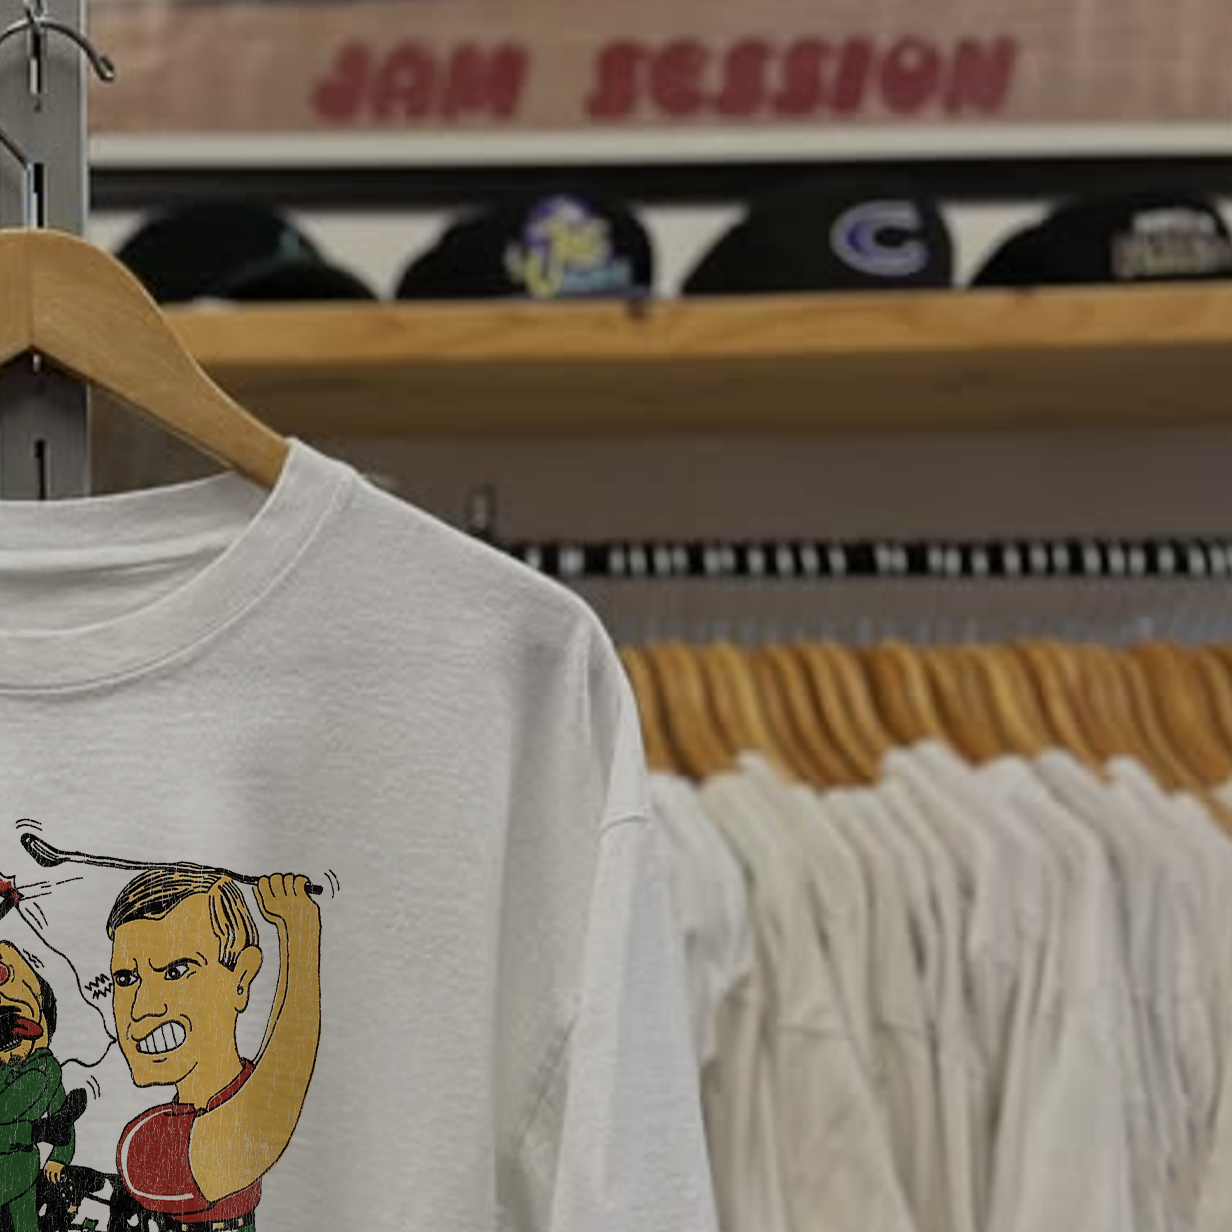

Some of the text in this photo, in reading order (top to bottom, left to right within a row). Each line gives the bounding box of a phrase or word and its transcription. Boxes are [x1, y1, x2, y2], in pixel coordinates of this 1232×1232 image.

[314, 37, 1018, 122] JAM SESSION
[829, 200, 927, 276] C
